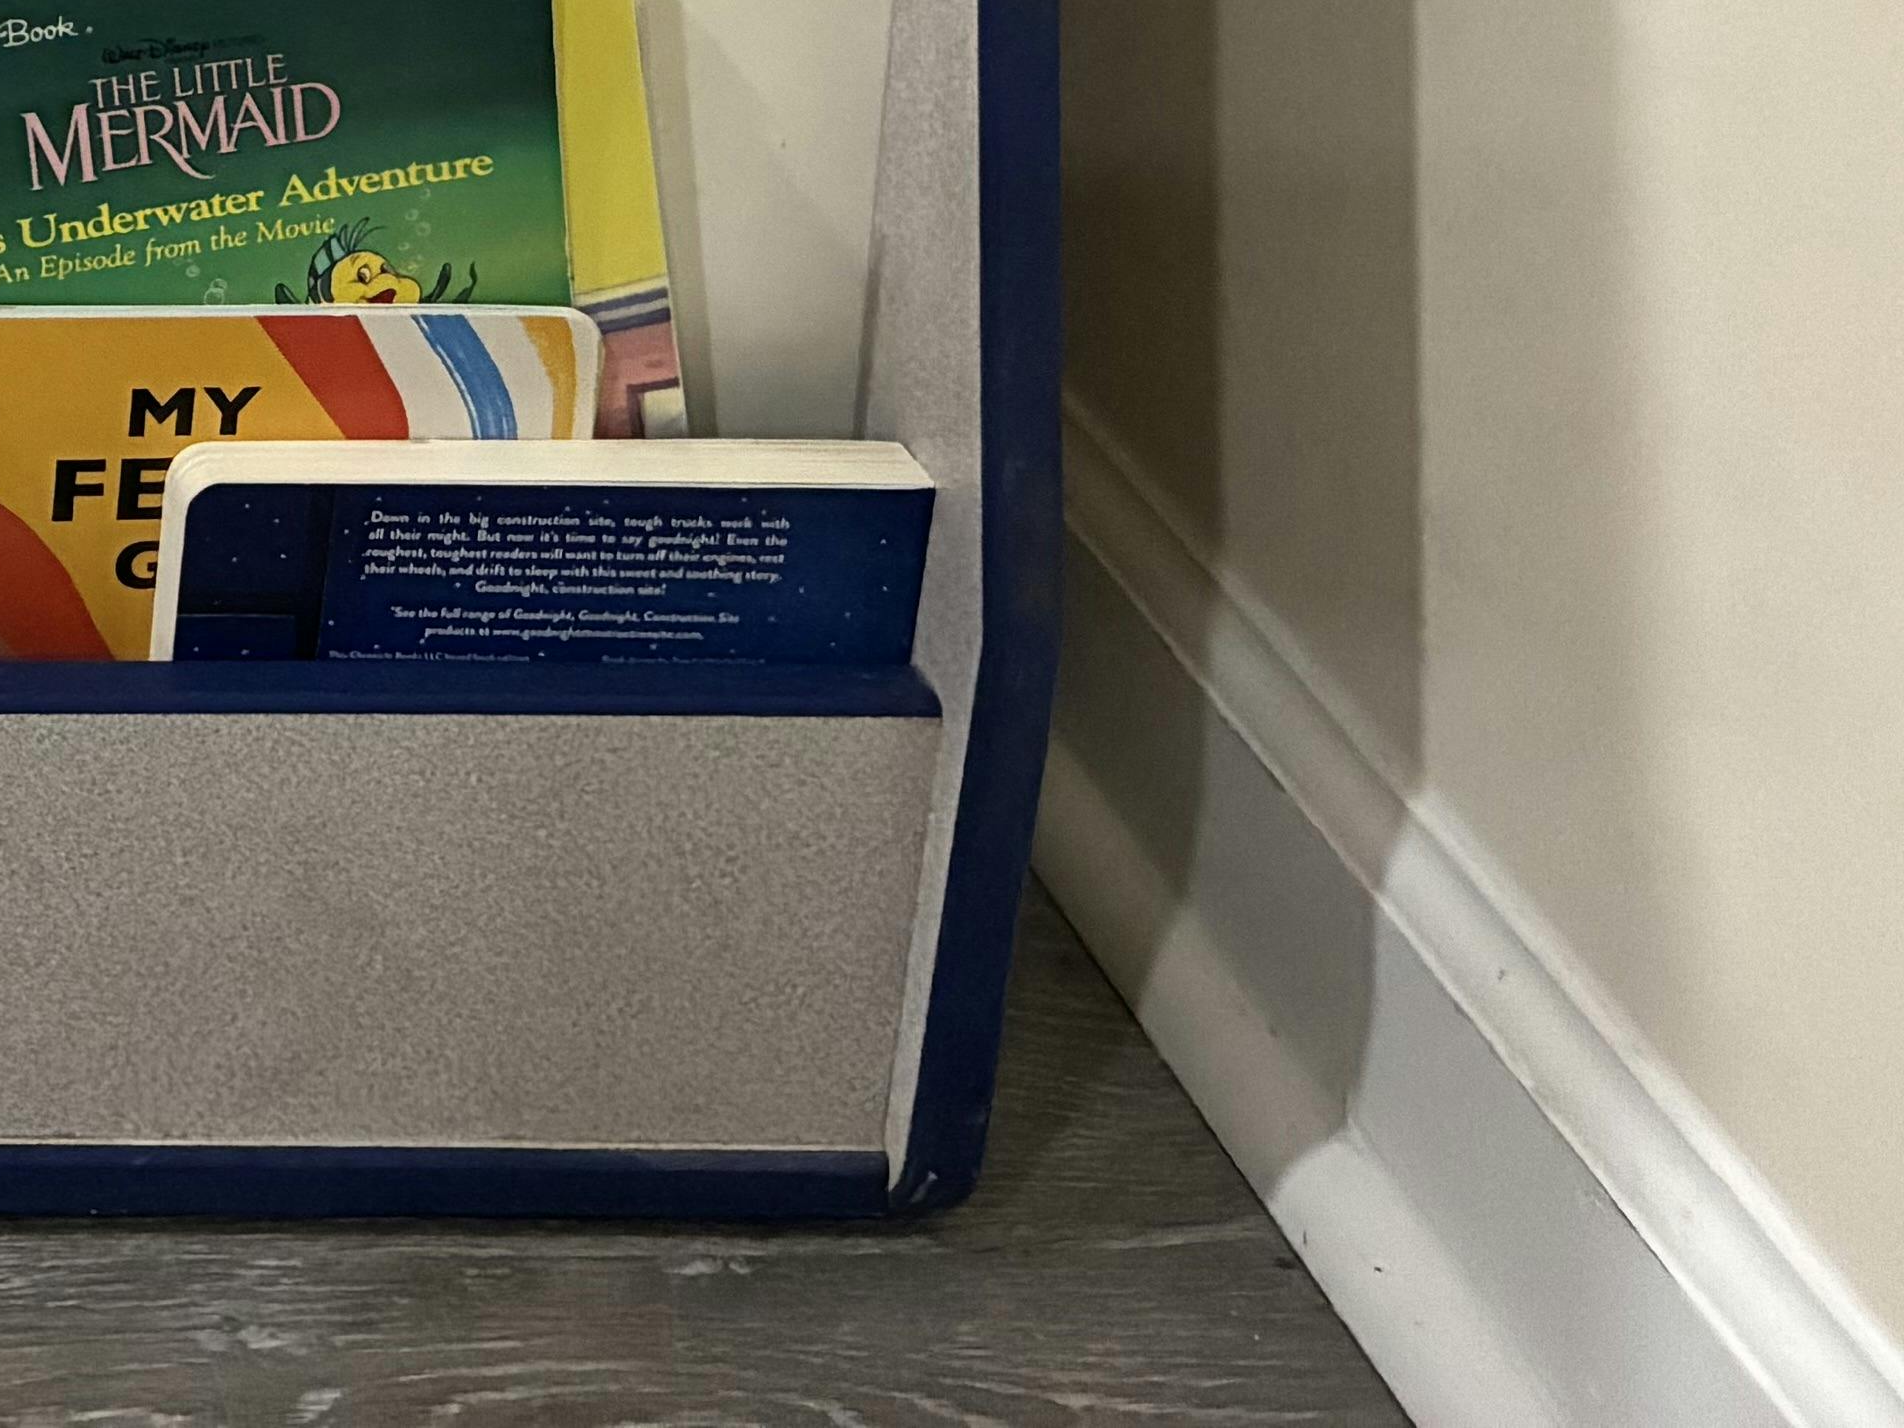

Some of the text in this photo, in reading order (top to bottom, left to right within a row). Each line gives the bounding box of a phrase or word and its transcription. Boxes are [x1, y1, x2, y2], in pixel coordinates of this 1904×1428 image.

[88, 53, 288, 109] THE LITTLE
[19, 81, 341, 191] MERMAID
[16, 187, 266, 249] Underwater
[278, 154, 495, 208] Adventure
[39, 247, 136, 280] Episode
[144, 237, 202, 267] from
[210, 228, 248, 252] the
[256, 215, 336, 243] Movie
[127, 387, 262, 438] MY
